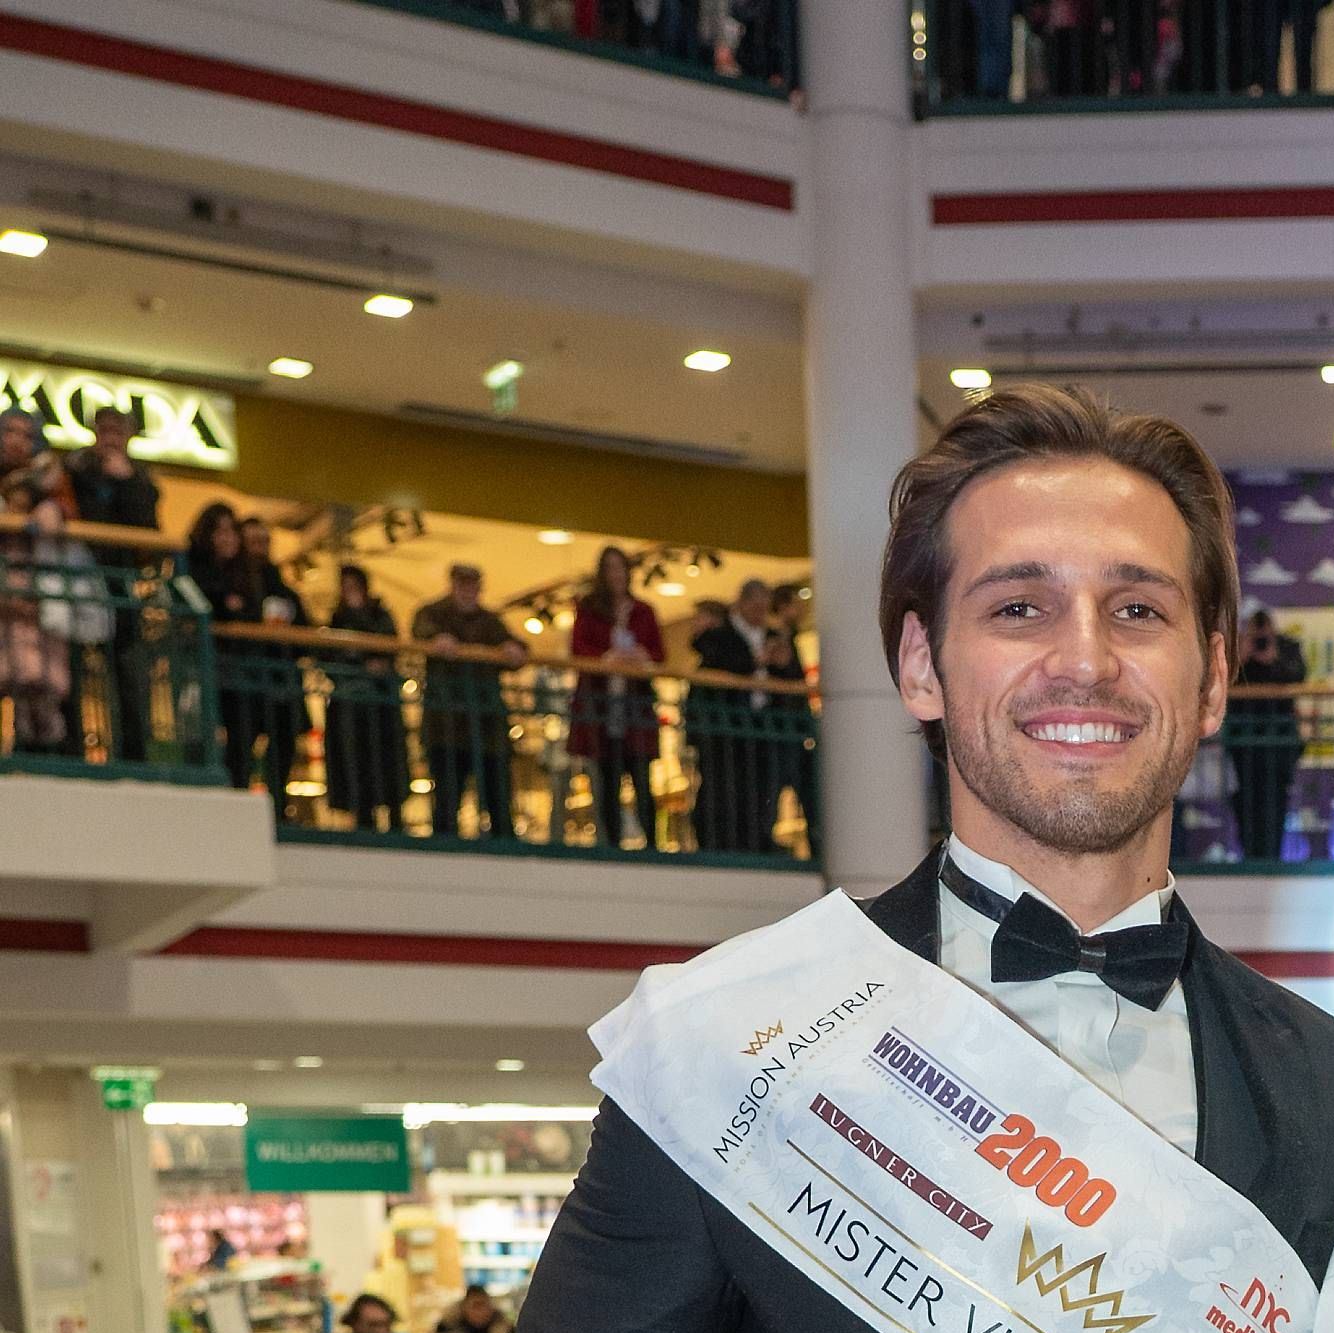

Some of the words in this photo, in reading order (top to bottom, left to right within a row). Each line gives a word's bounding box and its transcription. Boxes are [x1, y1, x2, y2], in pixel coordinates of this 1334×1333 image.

[712, 1056, 786, 1164] MISSION
[788, 981, 885, 1059] AUSTRIA
[872, 1031, 997, 1134] WOHNBAU
[974, 1113, 1118, 1228] 2000
[256, 1140, 399, 1163] WILLKOMMEN
[816, 1099, 918, 1188] LUGNER
[928, 1189, 987, 1232] CITY
[787, 1181, 944, 1327] MISTER
